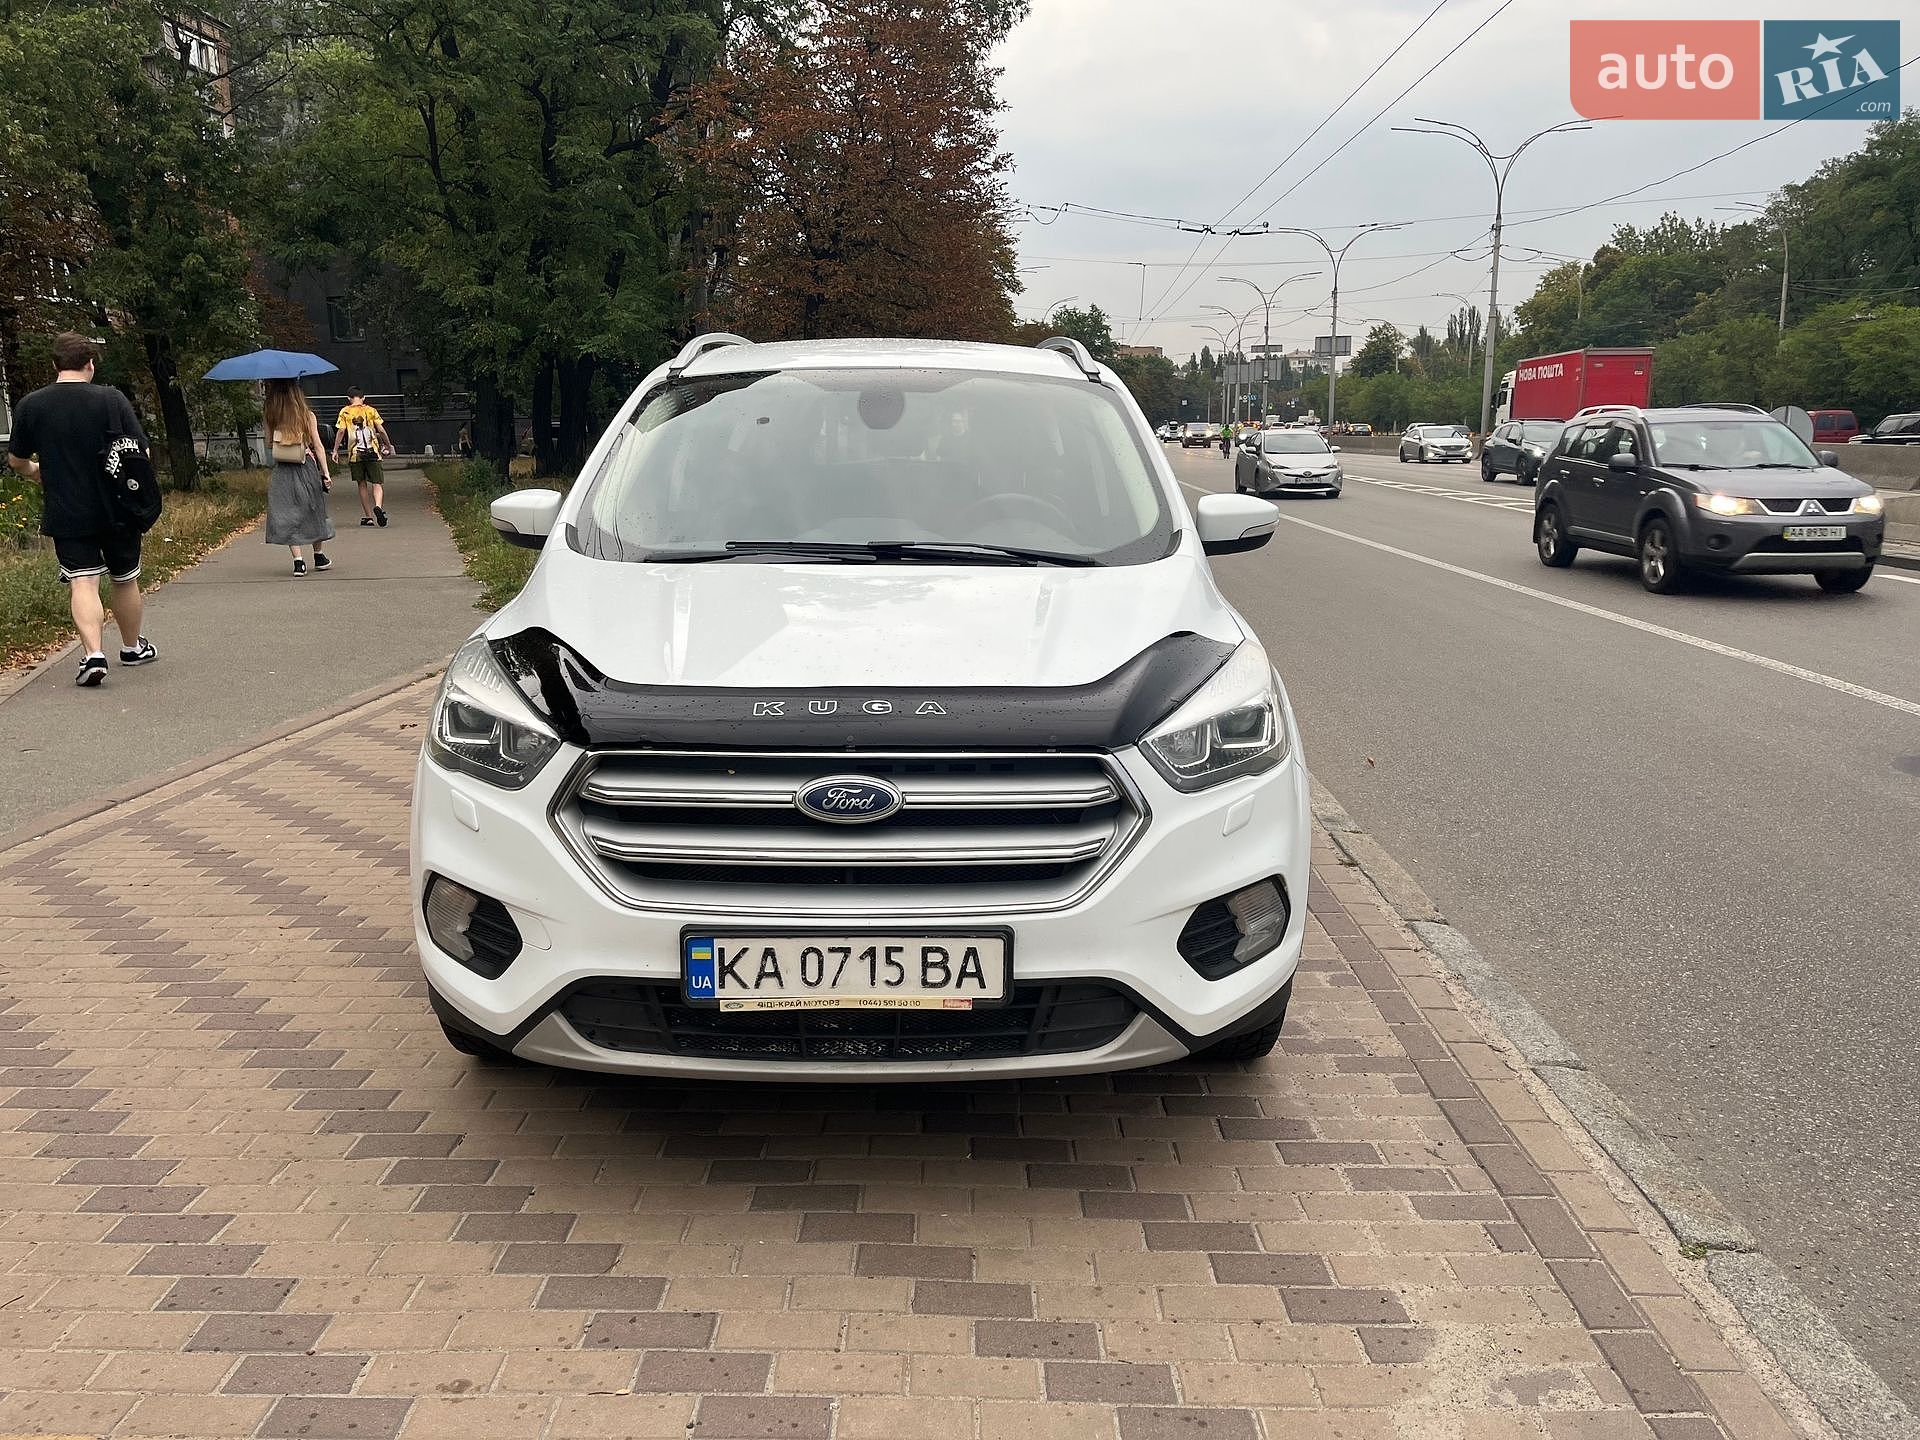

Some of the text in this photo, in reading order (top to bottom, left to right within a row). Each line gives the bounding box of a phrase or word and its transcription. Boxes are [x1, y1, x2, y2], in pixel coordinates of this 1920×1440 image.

[1518, 363, 1564, 381] НОВА ПОШТА
[753, 700, 947, 716] KUGA
[821, 787, 876, 811] Ford
[717, 946, 987, 990] KA 0715 BA
[692, 975, 712, 989] UA
[858, 999, 882, 1007] (044)
